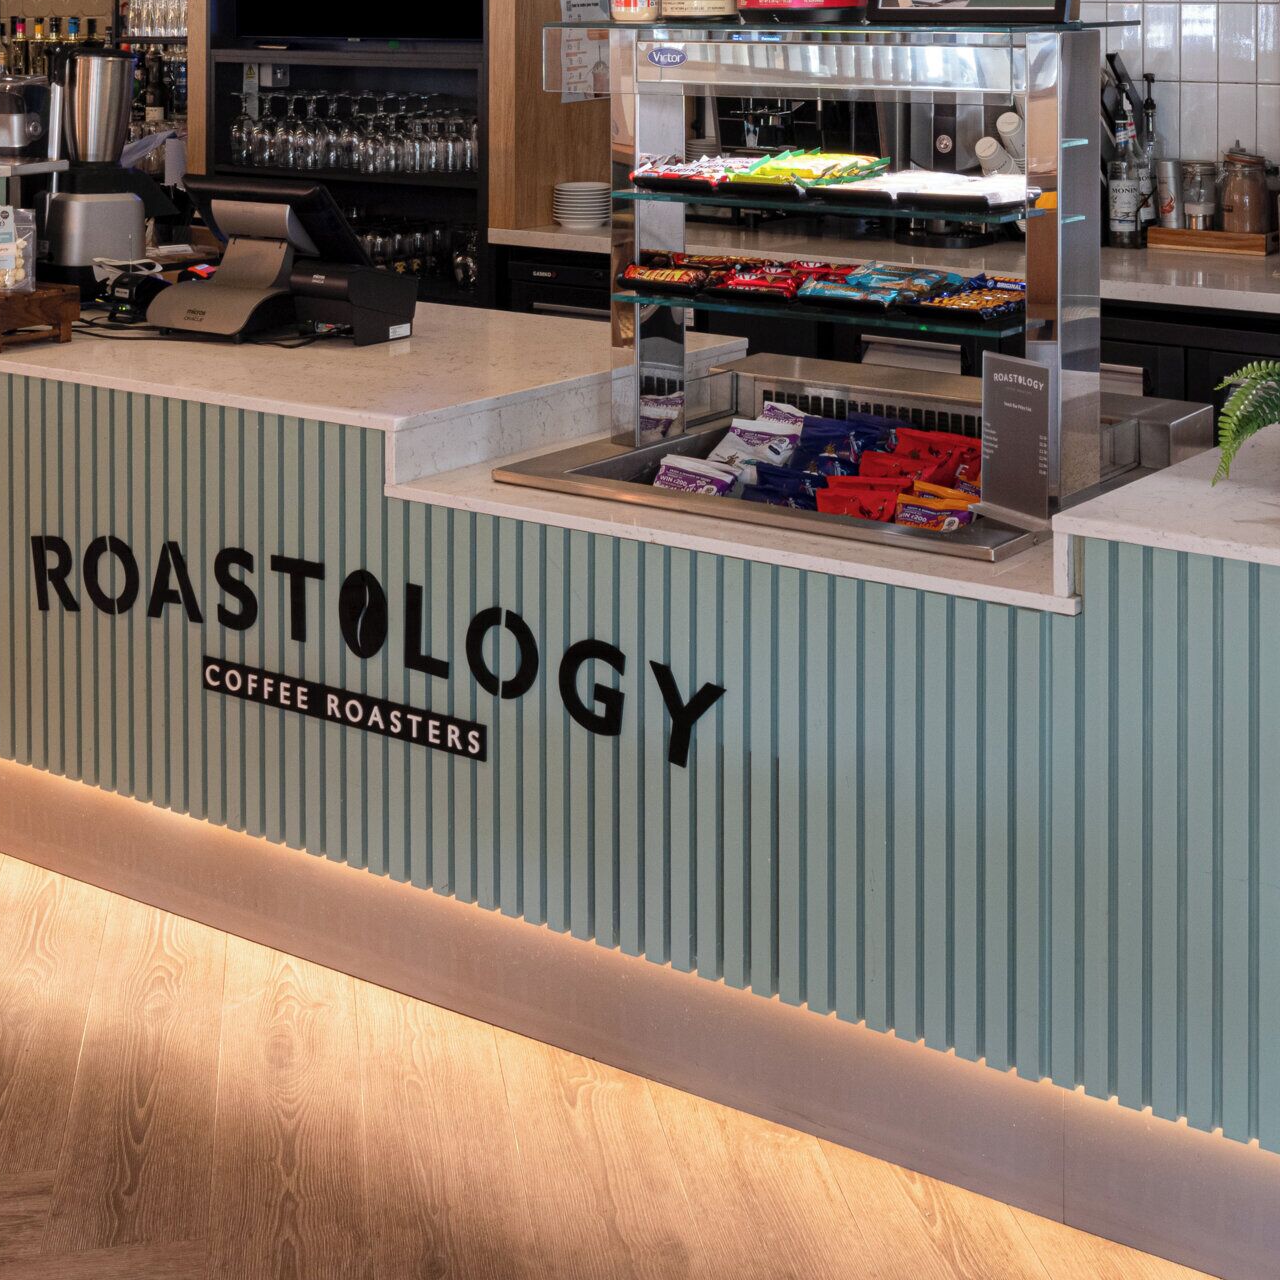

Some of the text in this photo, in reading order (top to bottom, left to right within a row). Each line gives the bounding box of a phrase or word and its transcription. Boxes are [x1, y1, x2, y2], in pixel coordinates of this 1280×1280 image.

[652, 52, 682, 63] Victor
[994, 373, 1044, 391] ROASTOLOGY
[30, 534, 727, 768] ROASTOLOGY
[204, 663, 482, 755] COFFEE ROASTERS
